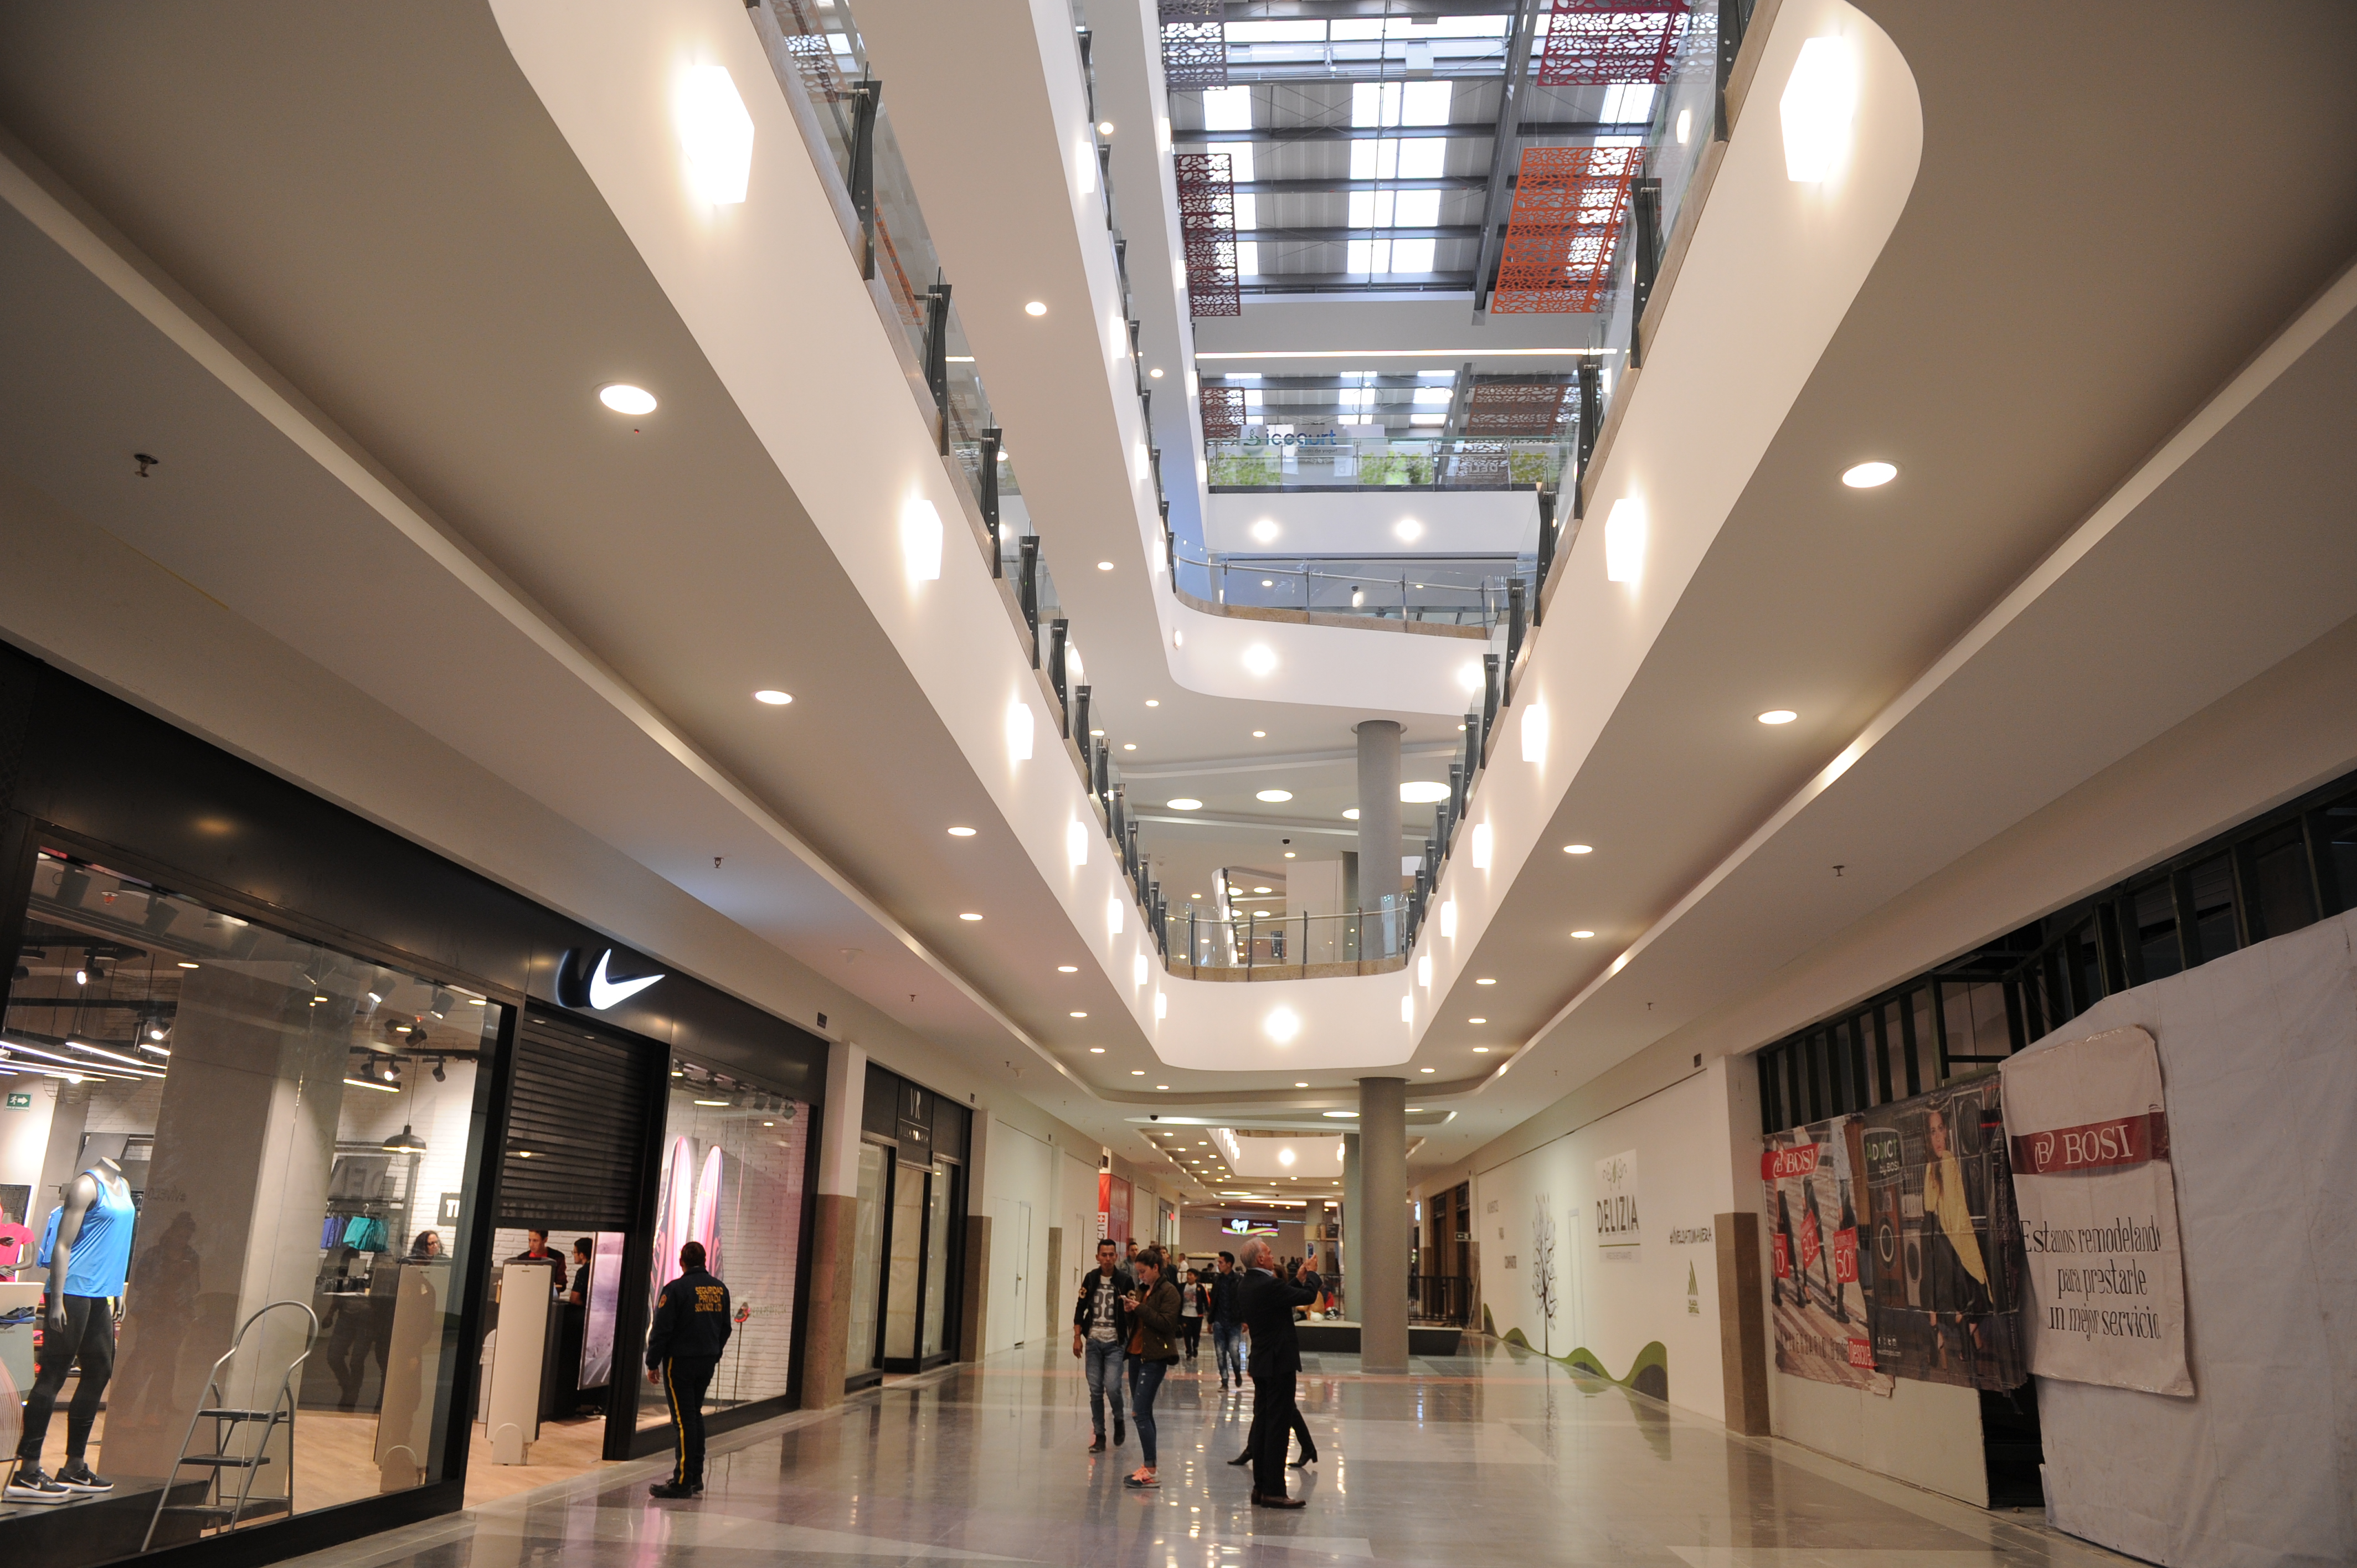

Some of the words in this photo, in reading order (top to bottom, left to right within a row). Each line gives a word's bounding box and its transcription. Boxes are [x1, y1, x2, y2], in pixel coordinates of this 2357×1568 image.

[910, 1088, 921, 1120] VR
[1786, 1148, 1814, 1173] BOSI
[2063, 1125, 2133, 1165] BOSI
[1597, 1194, 1639, 1234] DELIZIA
[2020, 1220, 2076, 1253] Estamos
[695, 1286, 723, 1296] SEGURIDAD
[2057, 1268, 2082, 1299] para
[2083, 1259, 2147, 1301] prestarle
[699, 1294, 721, 1303] PRIVADA
[2069, 1303, 2099, 1342] mejor
